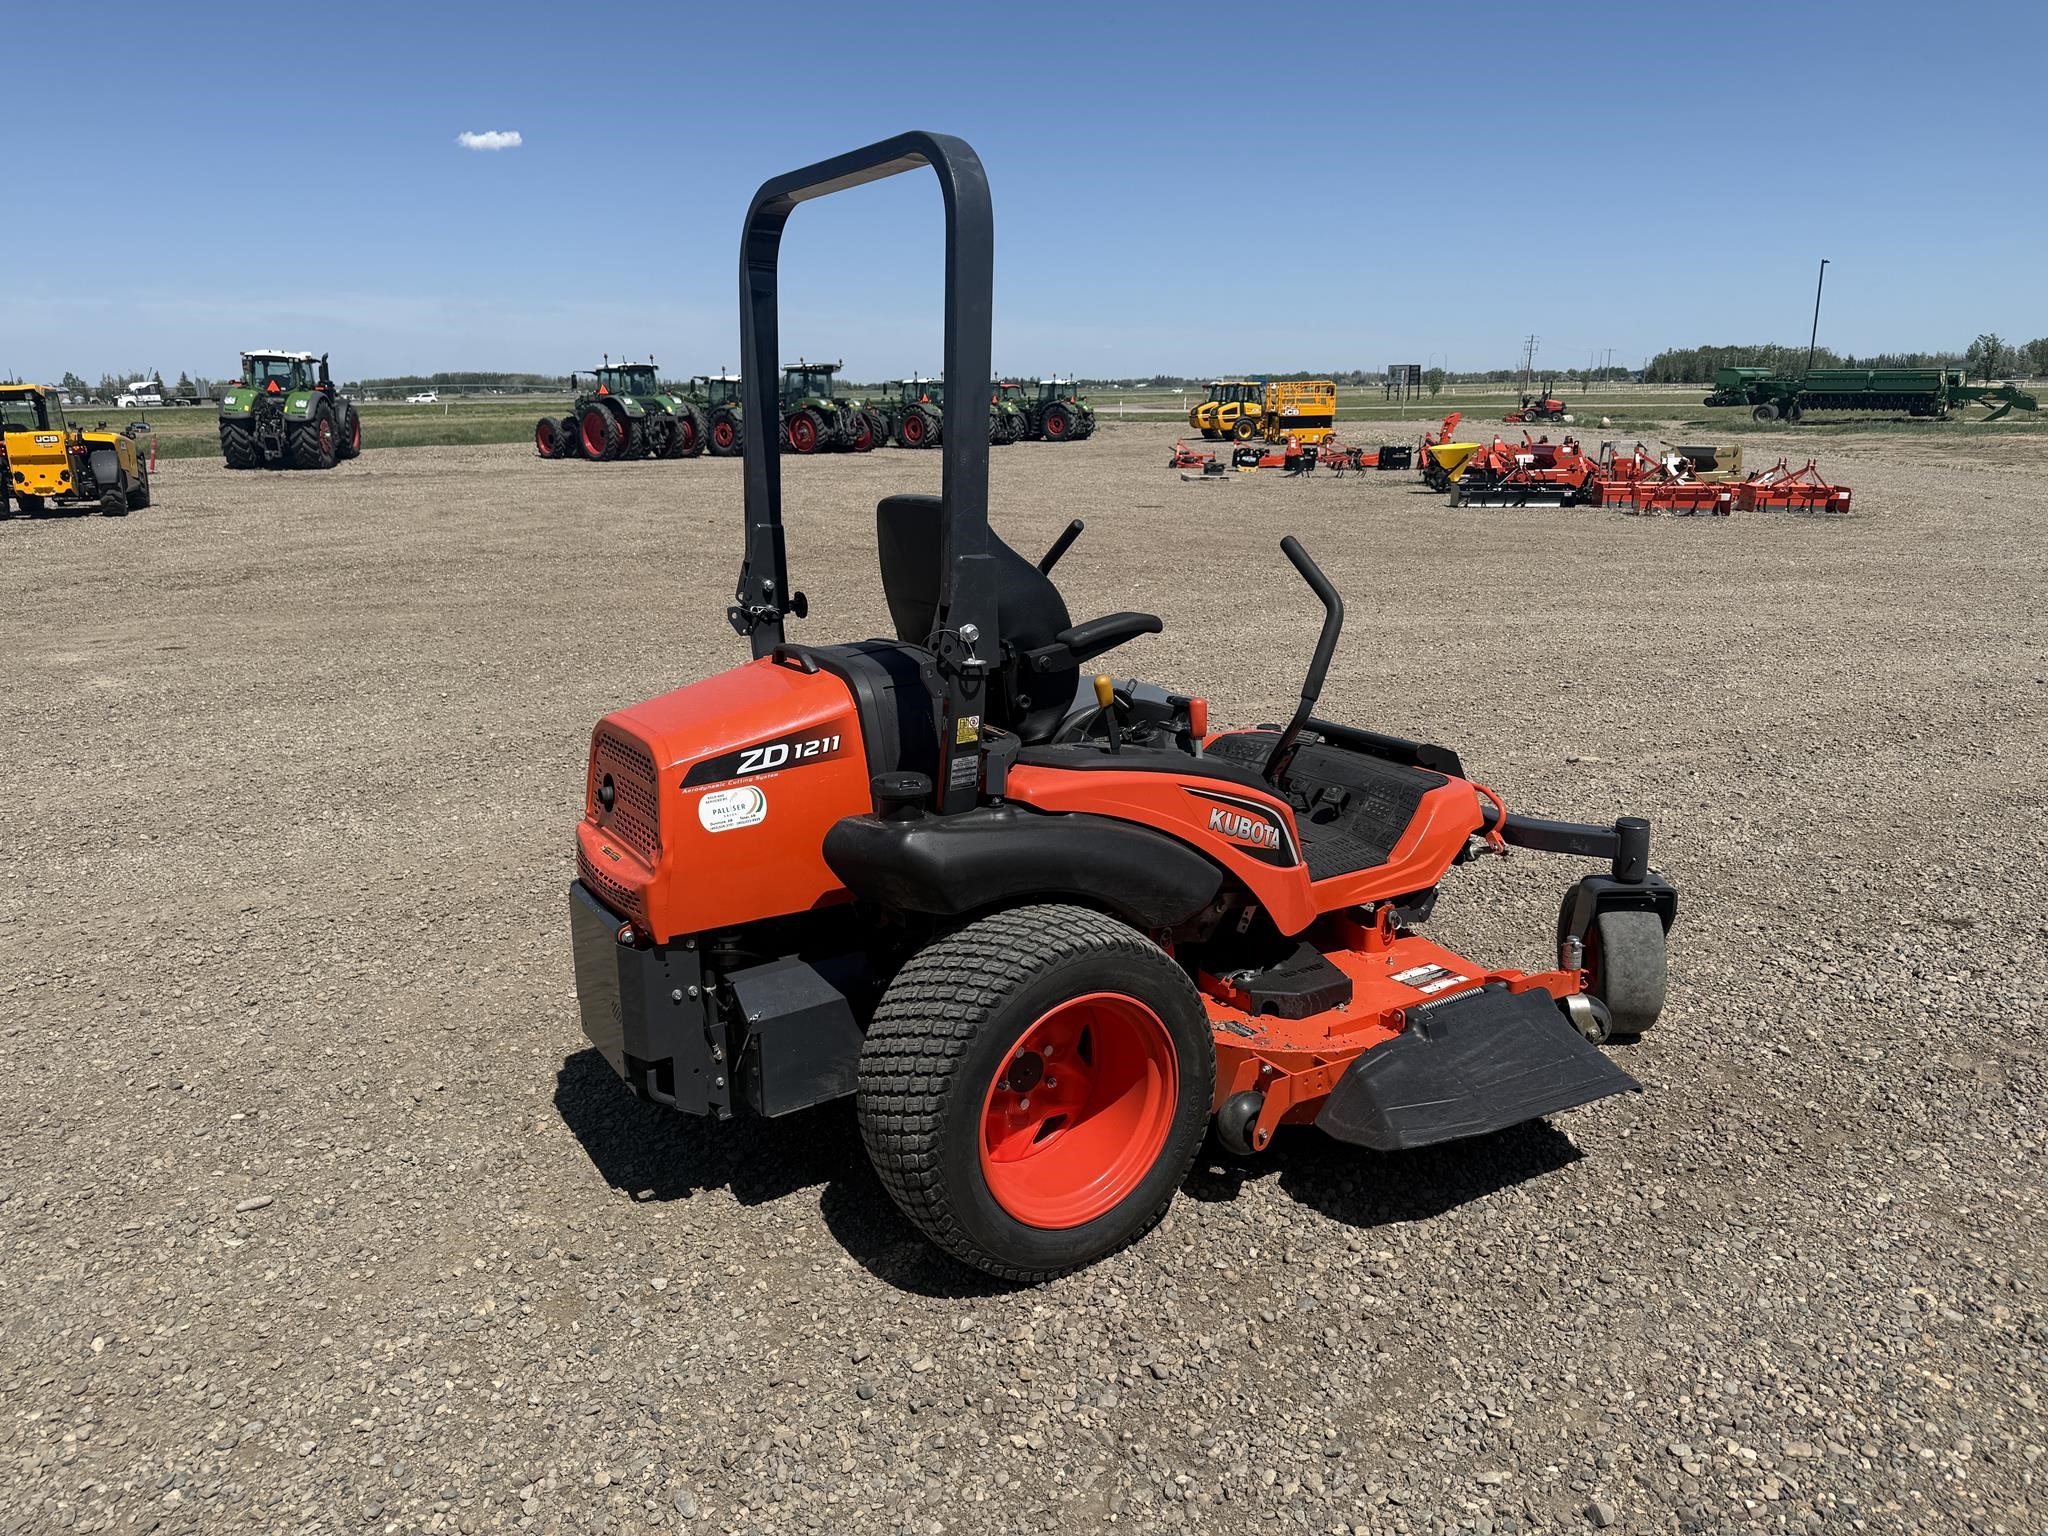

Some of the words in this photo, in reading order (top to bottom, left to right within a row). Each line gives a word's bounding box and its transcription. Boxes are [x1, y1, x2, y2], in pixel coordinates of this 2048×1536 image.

[35, 435, 58, 443] JCB
[736, 743, 789, 775] ZD
[794, 734, 840, 759] 1211
[682, 782, 726, 794] Aerodynamic
[727, 777, 753, 787] Cutting
[754, 773, 779, 782] System
[1208, 807, 1280, 850] KUBOTA
